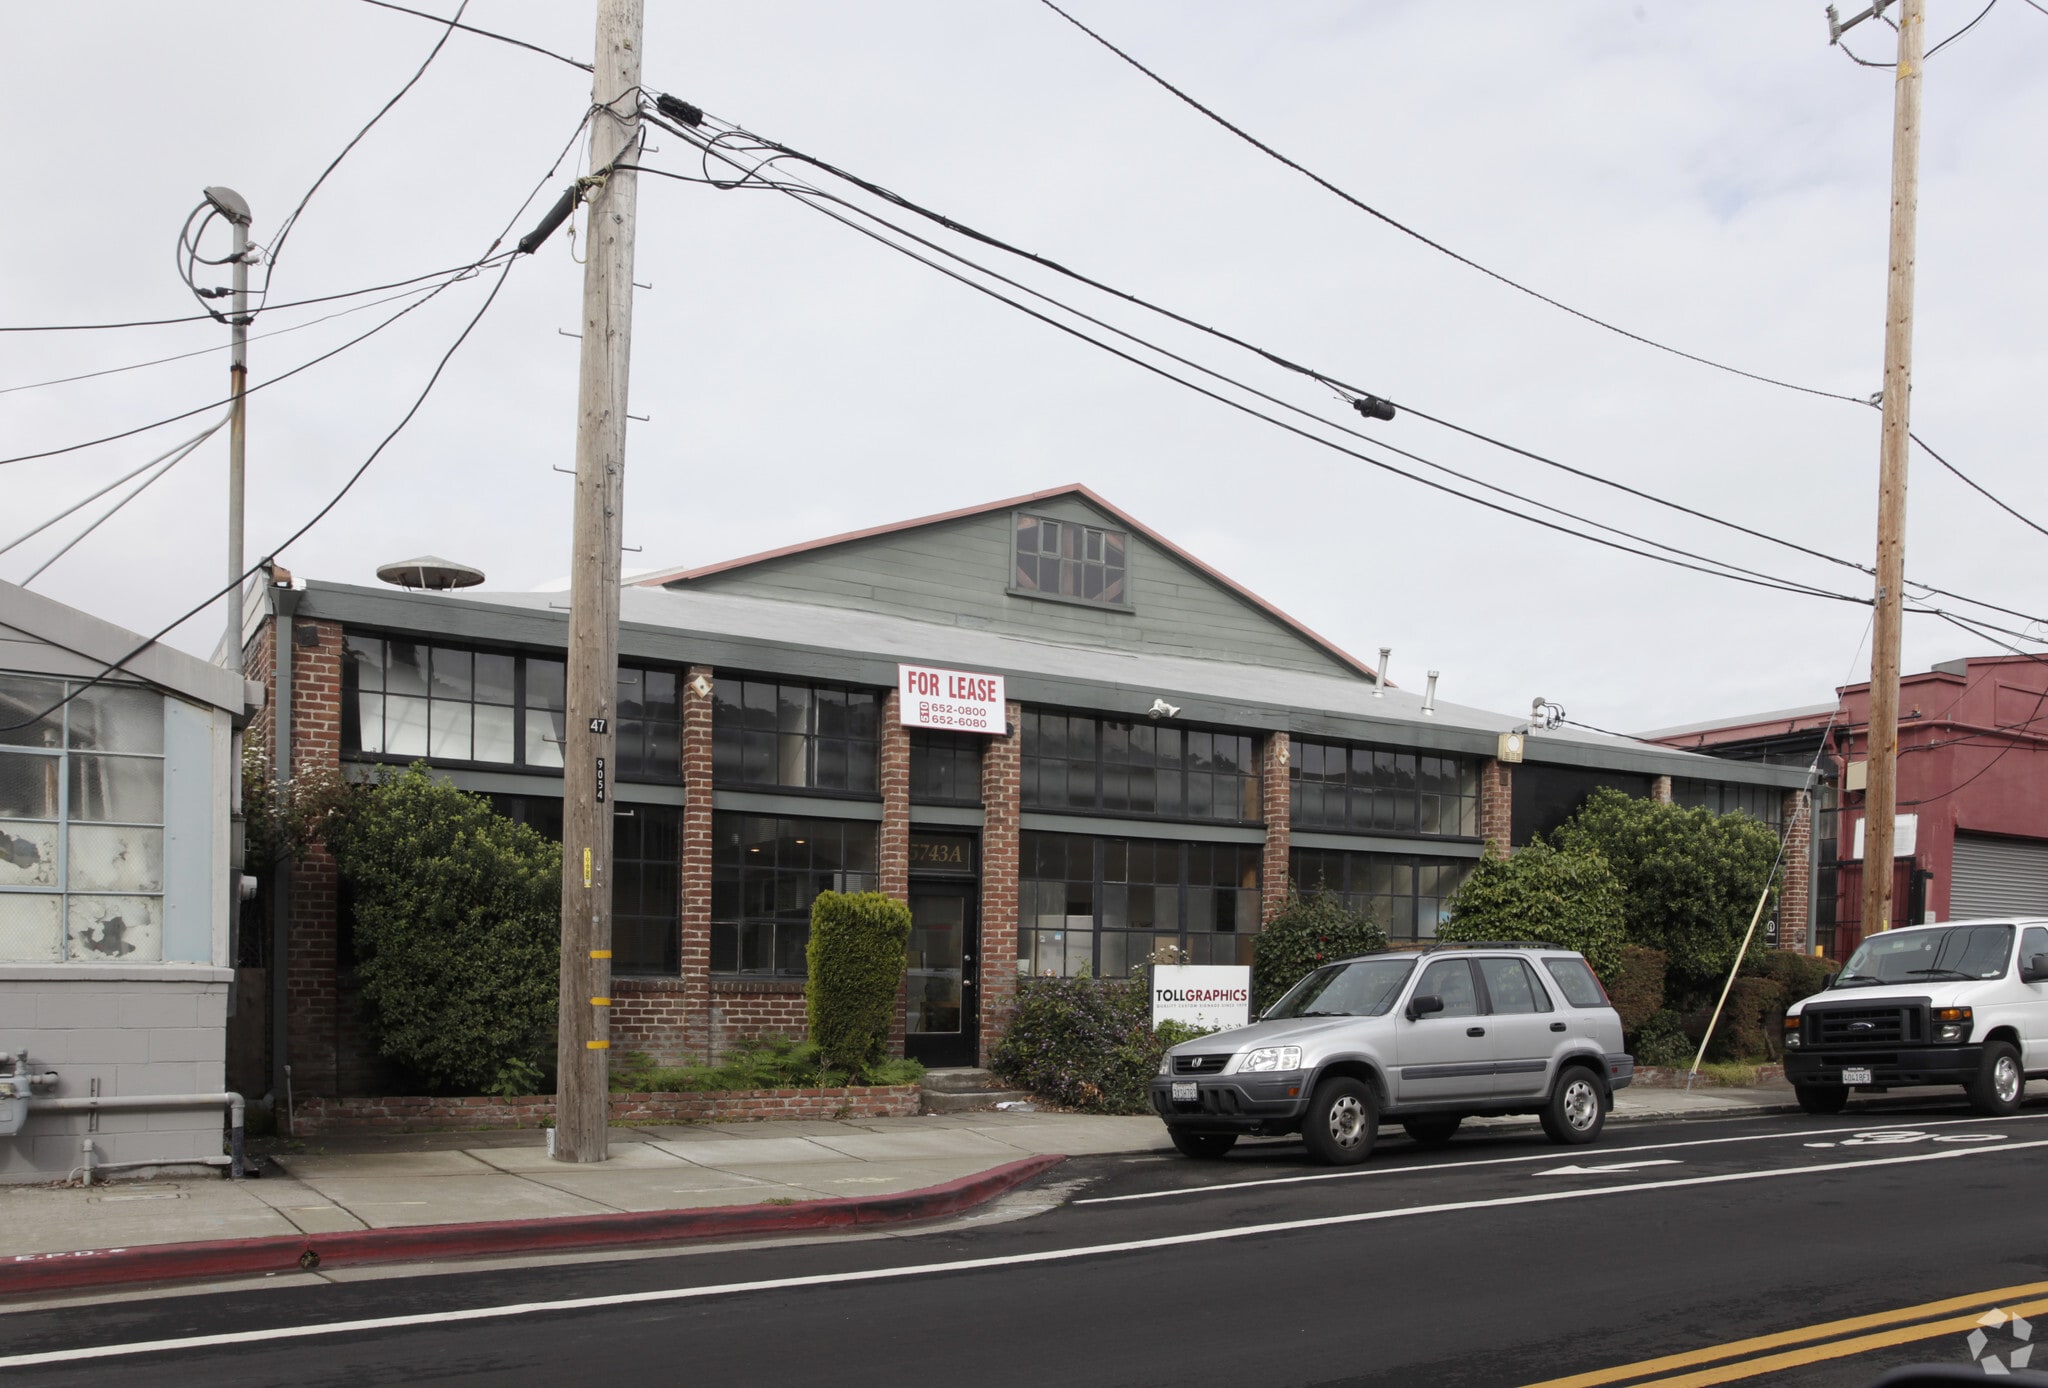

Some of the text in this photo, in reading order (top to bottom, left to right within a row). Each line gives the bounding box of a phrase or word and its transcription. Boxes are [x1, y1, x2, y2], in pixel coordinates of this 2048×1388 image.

[908, 671, 997, 702] FOR LEASE
[931, 703, 987, 717] 652-0800
[590, 719, 605, 732] 47
[931, 715, 987, 728] 652-6080
[910, 843, 963, 863] 5743A
[1156, 989, 1247, 1002] TOLLGRAPHICS
